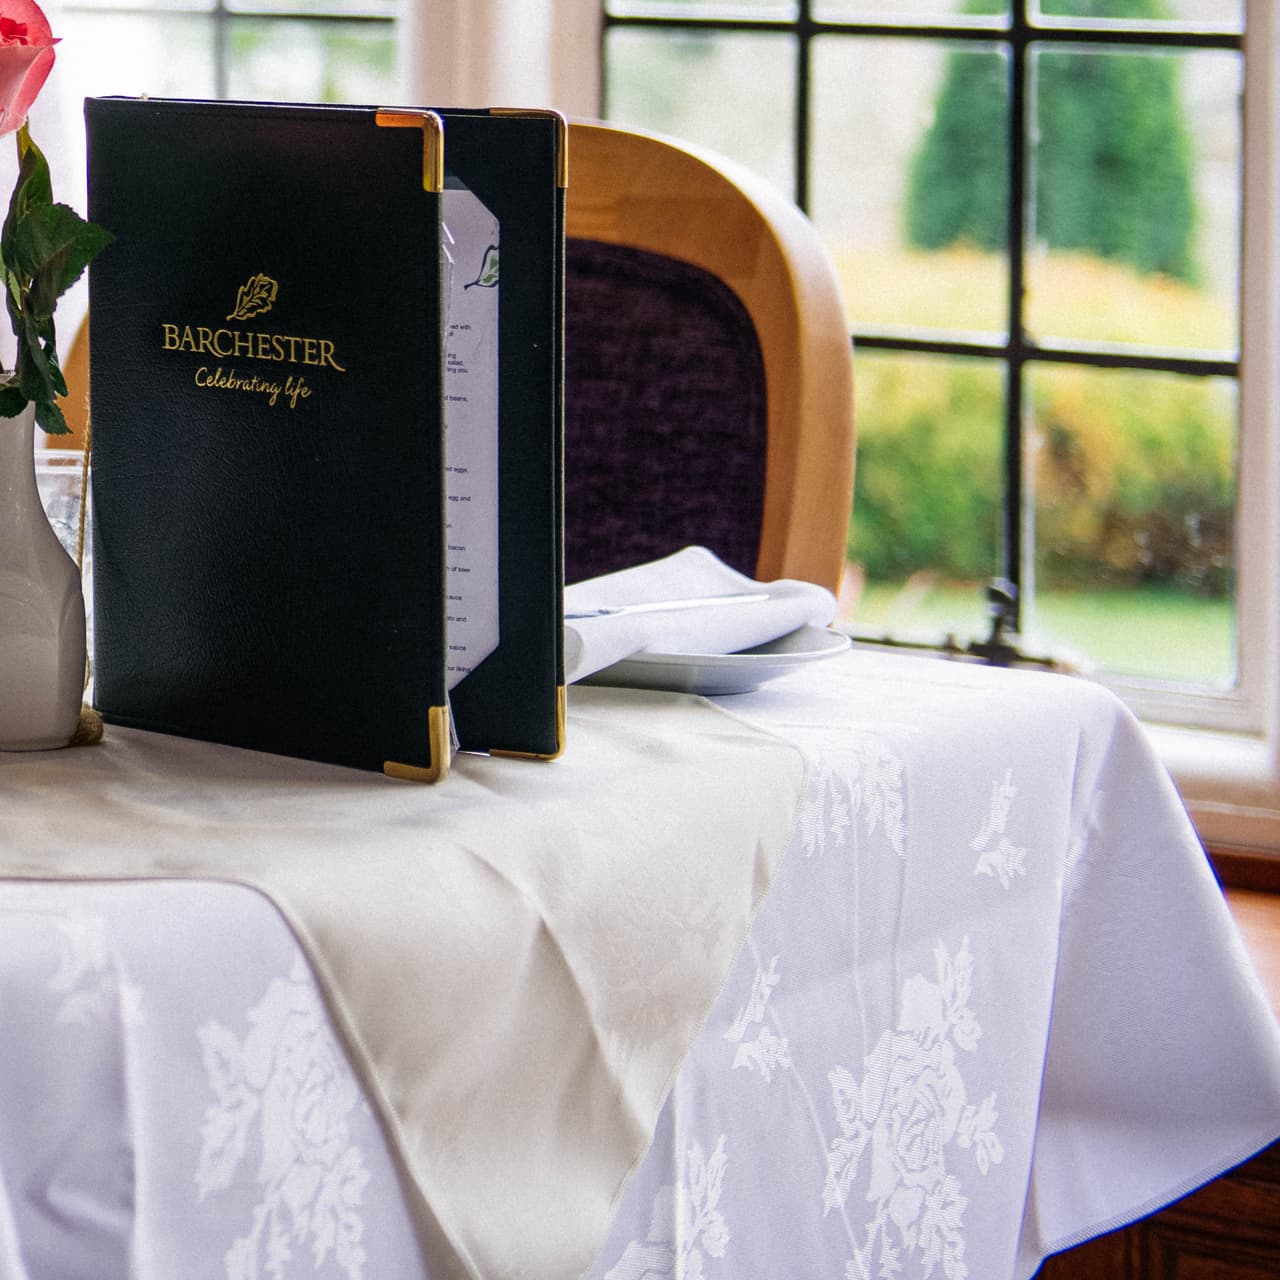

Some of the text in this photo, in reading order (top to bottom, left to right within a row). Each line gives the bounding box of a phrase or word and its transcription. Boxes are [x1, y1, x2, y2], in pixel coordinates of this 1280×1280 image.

[162, 323, 346, 372] BARCHESTER
[194, 366, 312, 409] Celebrating life
